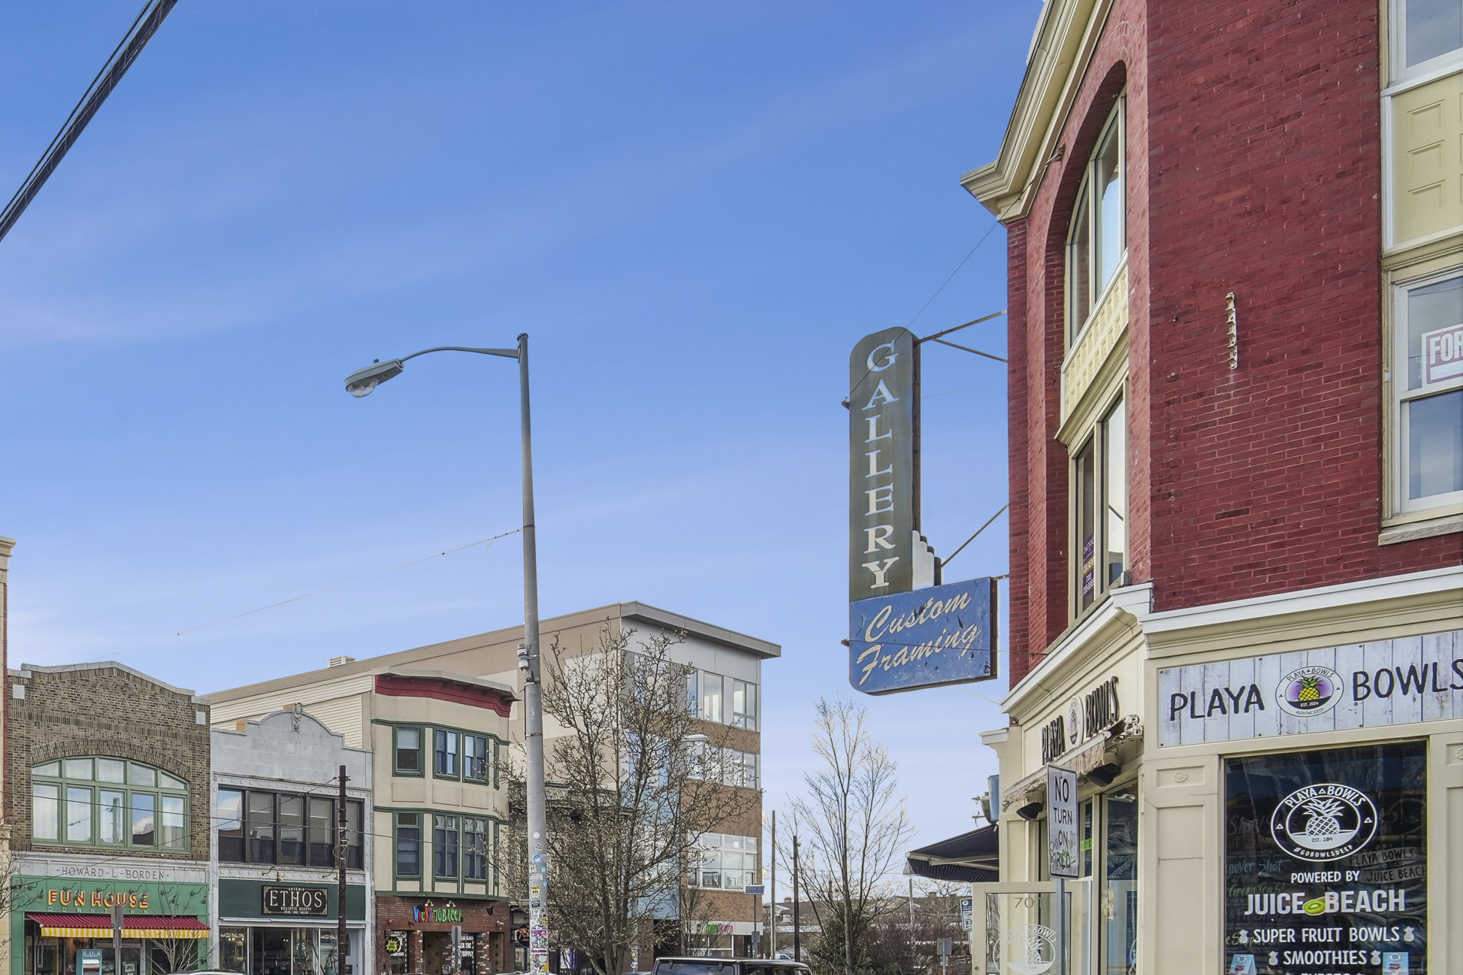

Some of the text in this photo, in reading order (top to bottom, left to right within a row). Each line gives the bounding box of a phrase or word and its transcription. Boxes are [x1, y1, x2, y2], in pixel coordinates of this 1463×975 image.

[862, 339, 899, 589] GALLERY
[864, 591, 971, 642] Custom
[857, 623, 981, 686] Framing
[1286, 668, 1335, 681] PLAYA BOWLS
[1170, 659, 1463, 721] PLAYA BOWLS
[1085, 676, 1120, 738] BOWLS
[1055, 776, 1069, 803] NO
[1285, 786, 1366, 808] PLAYA BOWLS
[1053, 808, 1073, 826] TURN
[1058, 830, 1068, 846] ON
[1056, 851, 1071, 869] RED
[1293, 844, 1353, 858] #GOBOWLSDEEP
[1349, 853, 1379, 865] PLAYA
[1382, 849, 1414, 861] BOWLS
[1291, 870, 1360, 884] POWERED BY
[1367, 870, 1395, 882] JUICE
[48, 890, 148, 908] FUN HOUSE
[270, 890, 322, 907] ETHOS
[1244, 892, 1305, 916] JUICE
[1325, 889, 1405, 914] BEACH
[1253, 928, 1295, 943] SUPER
[1301, 927, 1343, 942] FRUIT
[1349, 926, 1400, 942] BOWLS
[1283, 950, 1367, 966] SMOOTHIES
